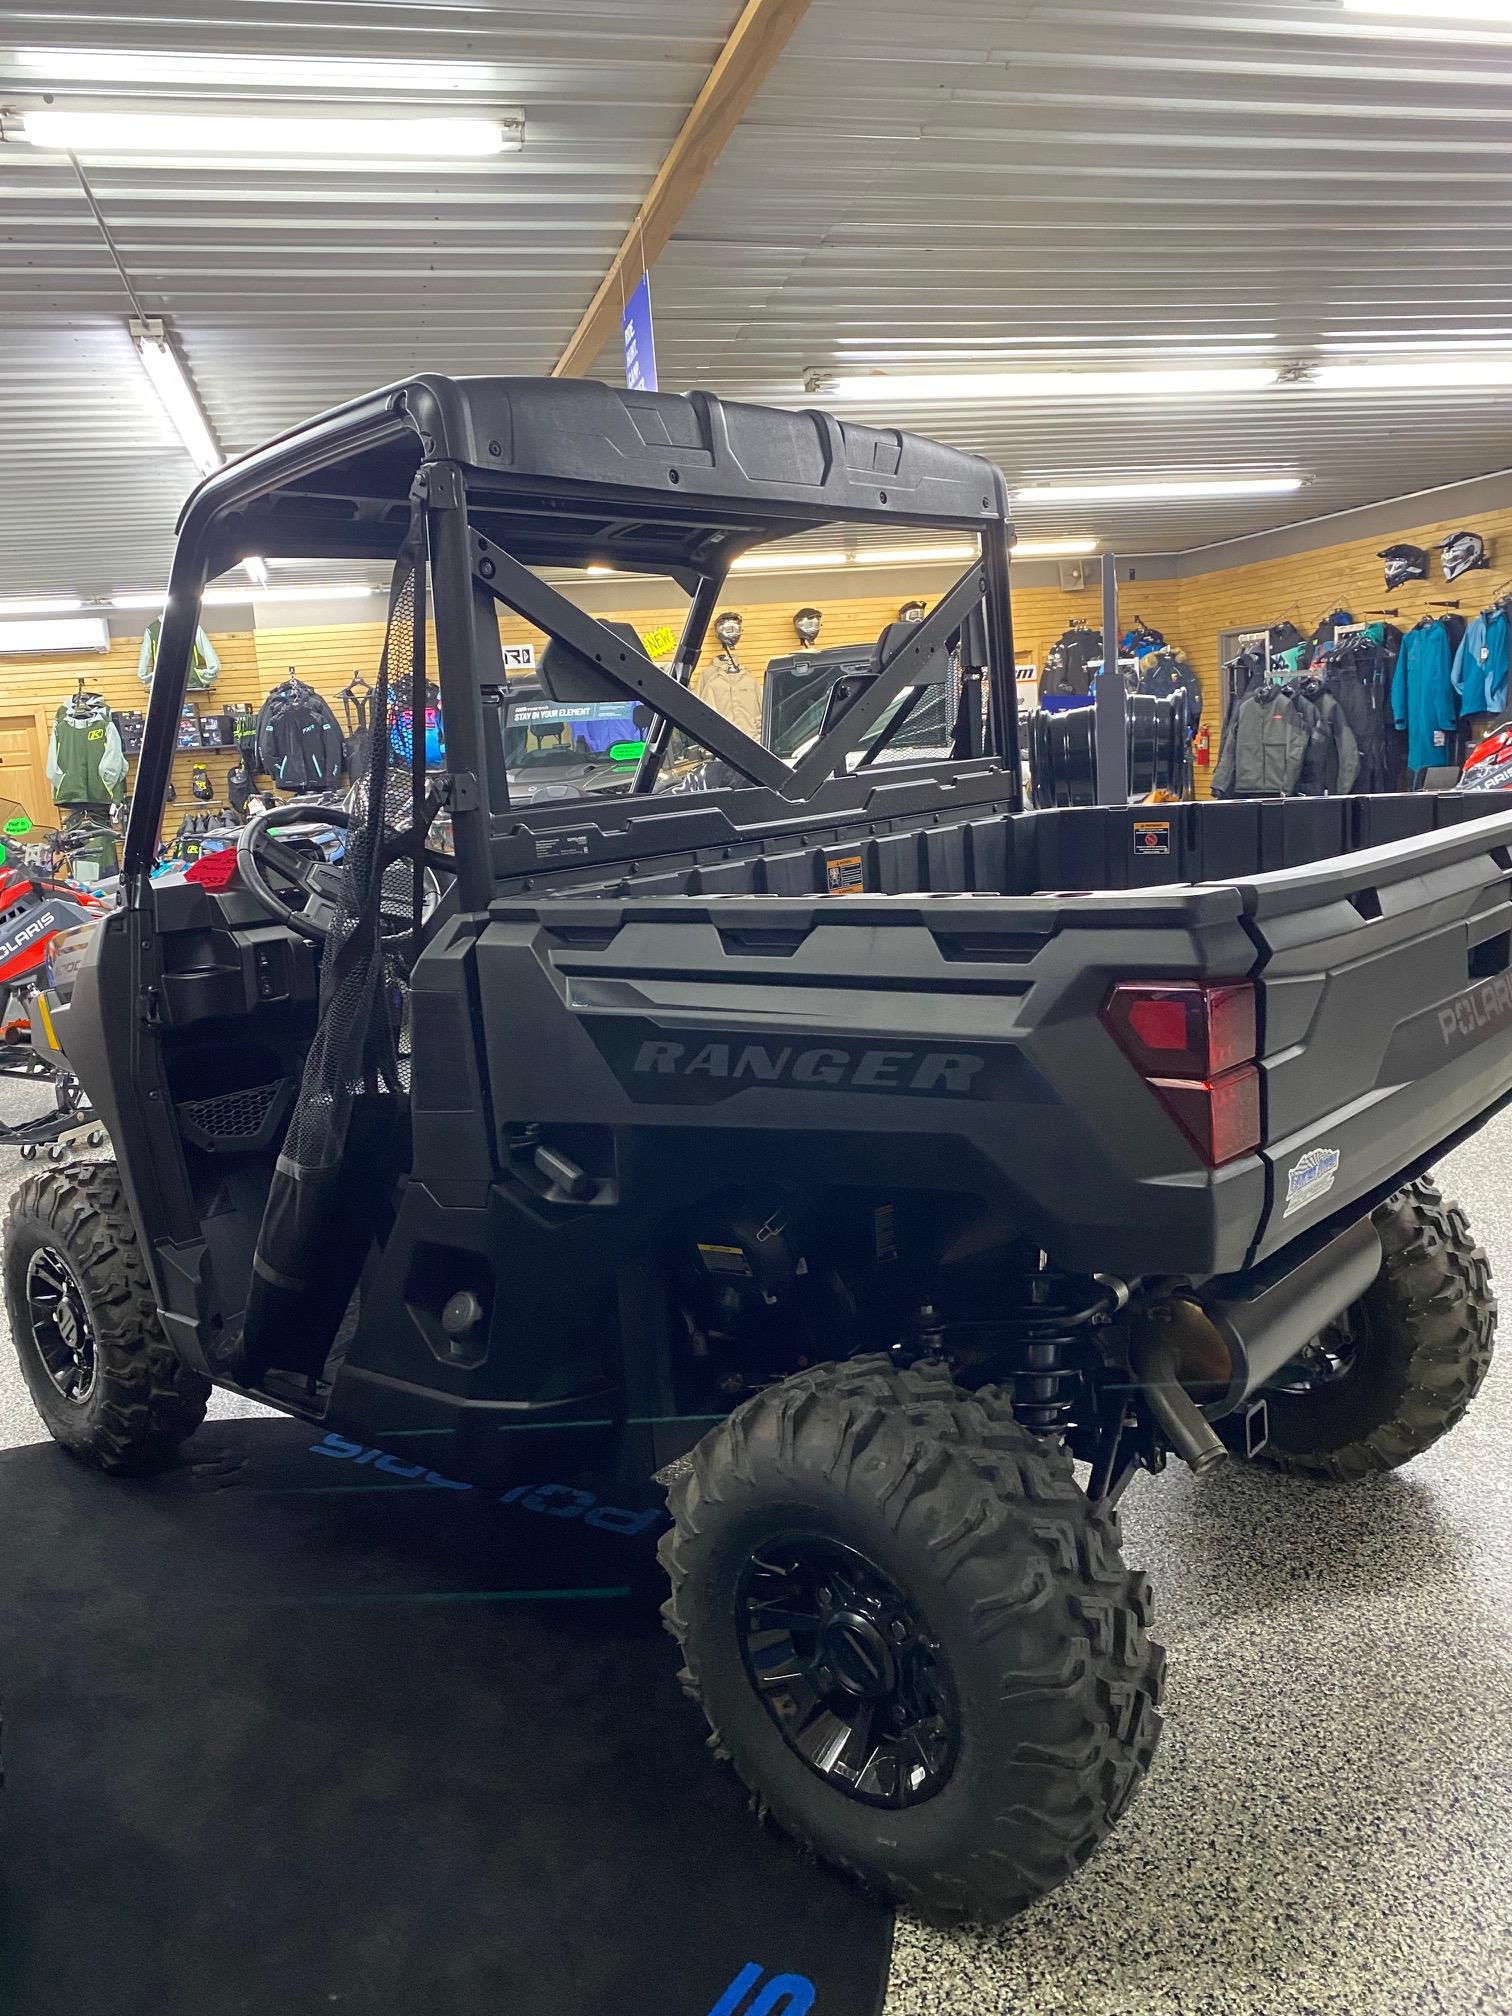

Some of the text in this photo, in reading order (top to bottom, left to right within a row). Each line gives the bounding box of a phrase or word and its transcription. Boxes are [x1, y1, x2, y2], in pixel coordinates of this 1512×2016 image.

[646, 629, 673, 652] NEW
[514, 713, 532, 722] STAY
[532, 711, 540, 719] IN
[540, 709, 559, 719] YOUR
[559, 707, 592, 717] ELEMENT
[0, 911, 55, 960] OLARIS
[633, 1040, 985, 1091] RANGER
